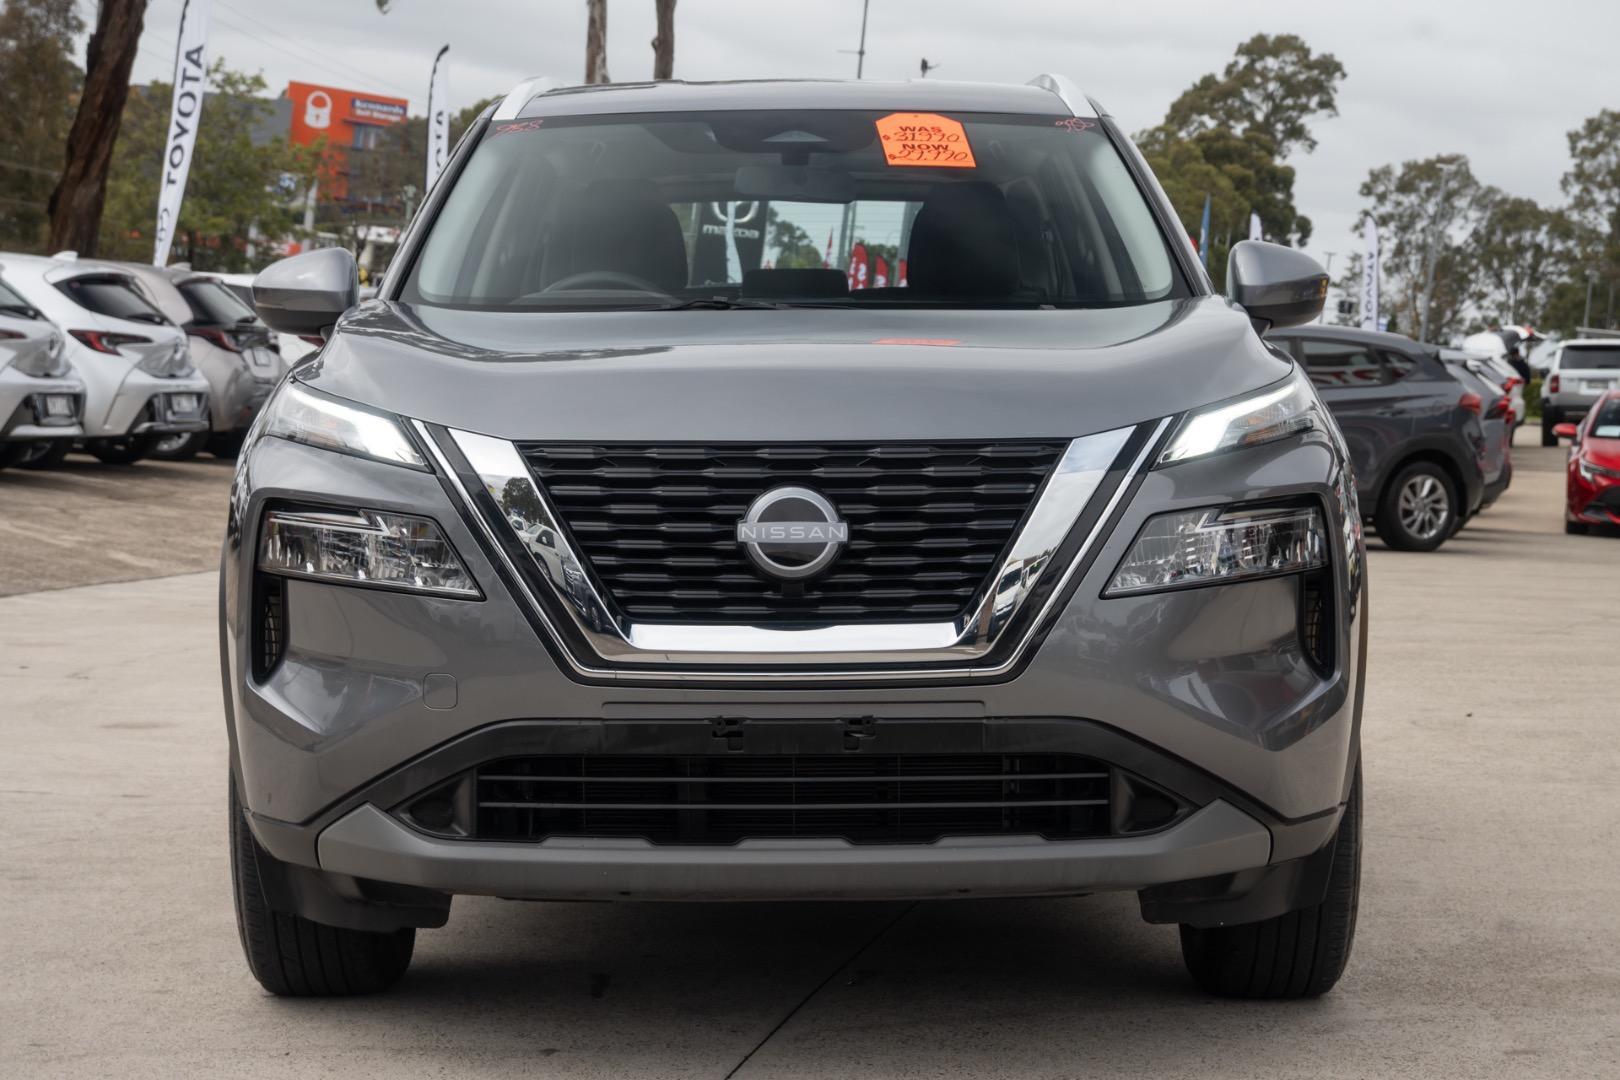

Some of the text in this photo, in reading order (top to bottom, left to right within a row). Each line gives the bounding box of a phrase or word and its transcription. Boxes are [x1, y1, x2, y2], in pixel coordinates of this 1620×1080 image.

[166, 45, 204, 187] TOYOTA
[902, 143, 949, 151] NOW
[741, 526, 845, 539] NISSAN
